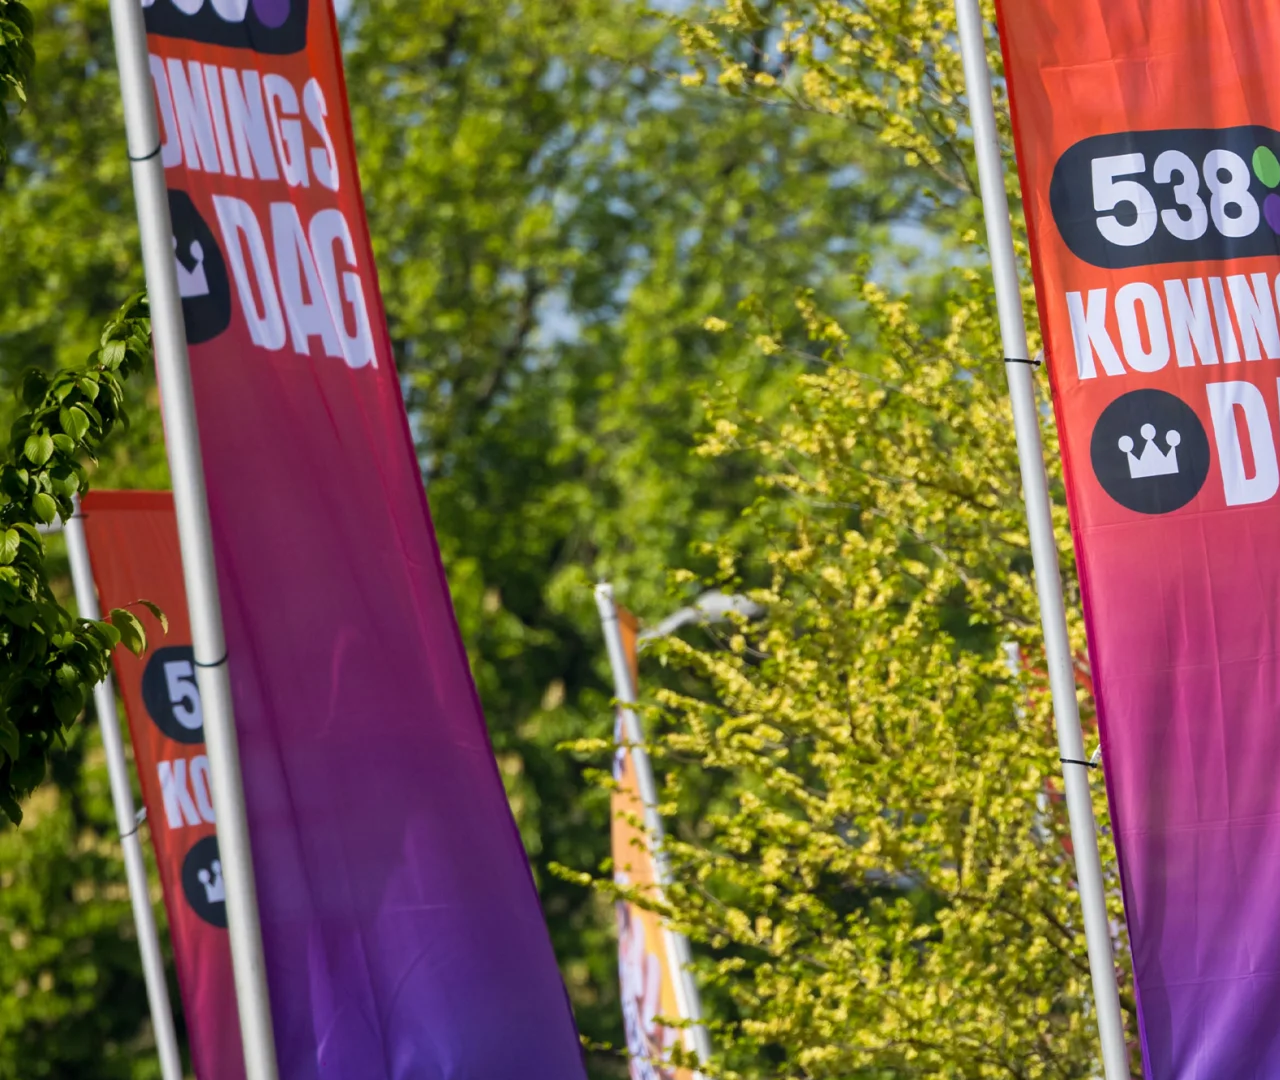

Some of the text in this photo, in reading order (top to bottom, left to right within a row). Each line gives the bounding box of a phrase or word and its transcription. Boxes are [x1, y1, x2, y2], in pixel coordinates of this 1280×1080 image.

[149, 54, 339, 192] ONINGS
[1090, 149, 1260, 247] 538
[212, 194, 379, 370] DAG
